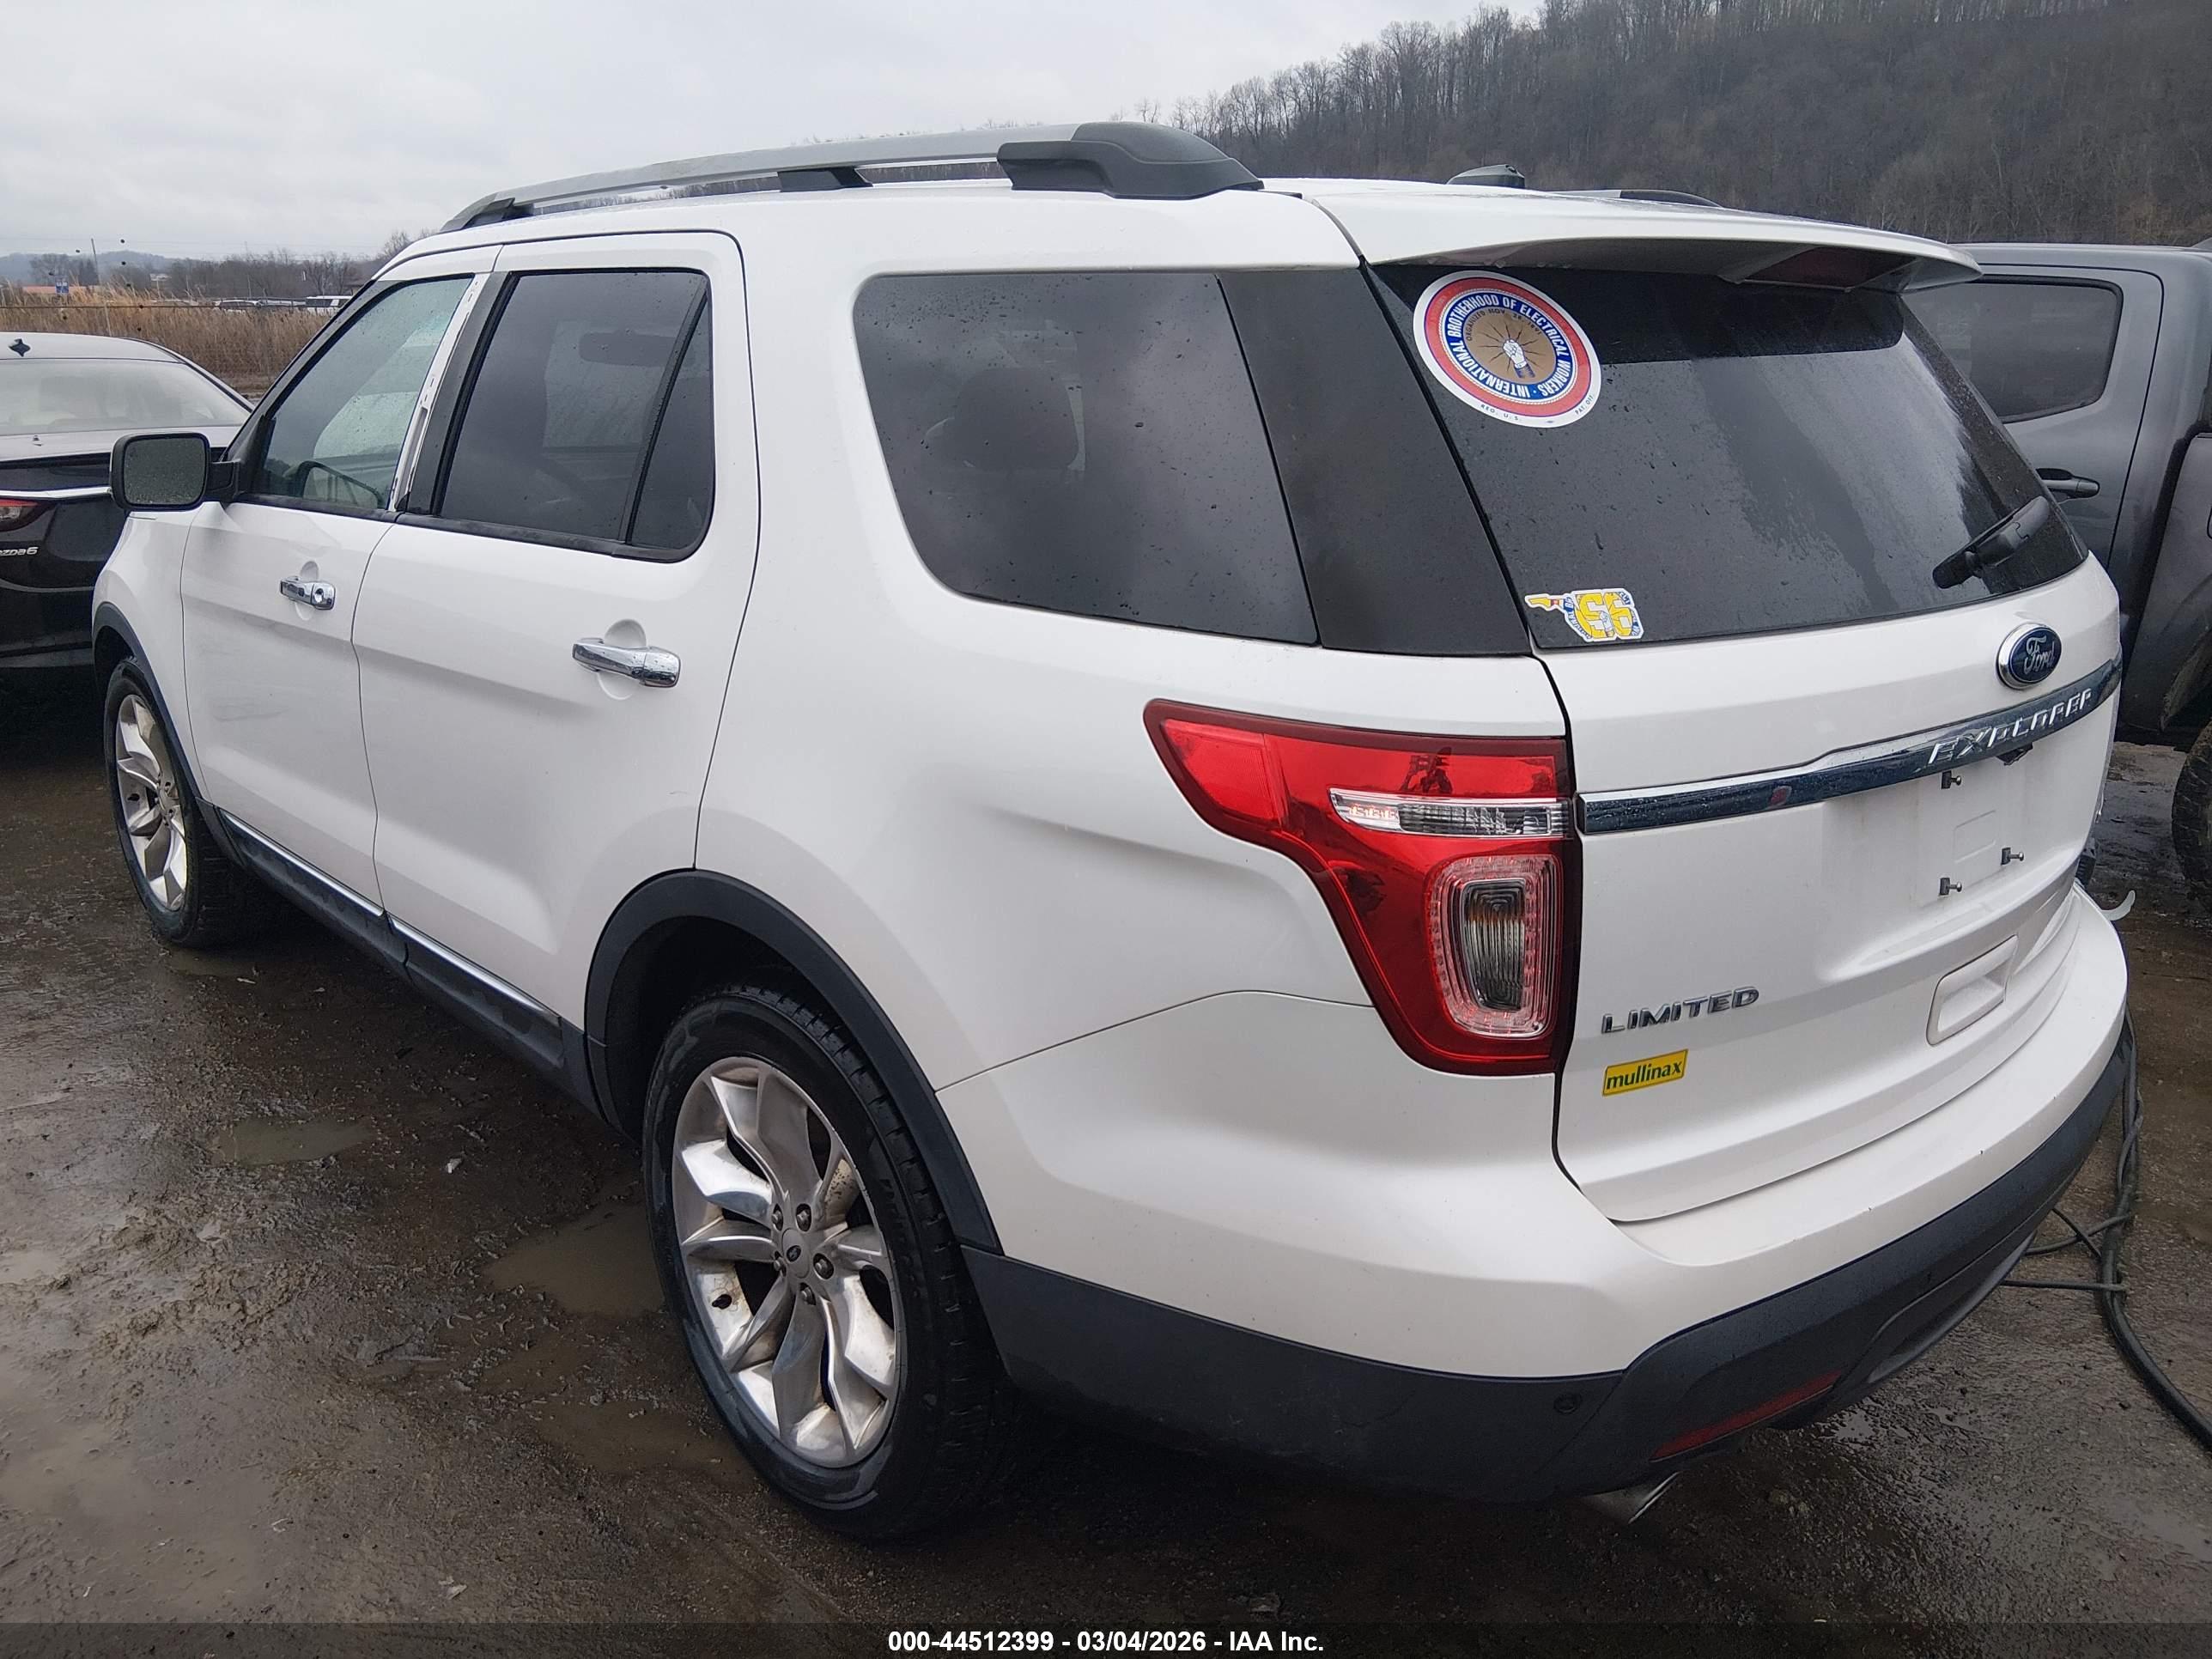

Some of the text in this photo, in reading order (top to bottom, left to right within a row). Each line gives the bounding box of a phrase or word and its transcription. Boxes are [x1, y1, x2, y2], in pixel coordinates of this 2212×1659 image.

[1448, 294, 1572, 398] INTERNATIONAL BROTHERHOOD OF ELECTRICAL WORKERS
[2023, 635, 2056, 674] Ford
[1928, 688, 2092, 764] EXPLORER
[1601, 986, 1759, 1034] LIMITED
[1606, 1060, 1683, 1090] mullinax
